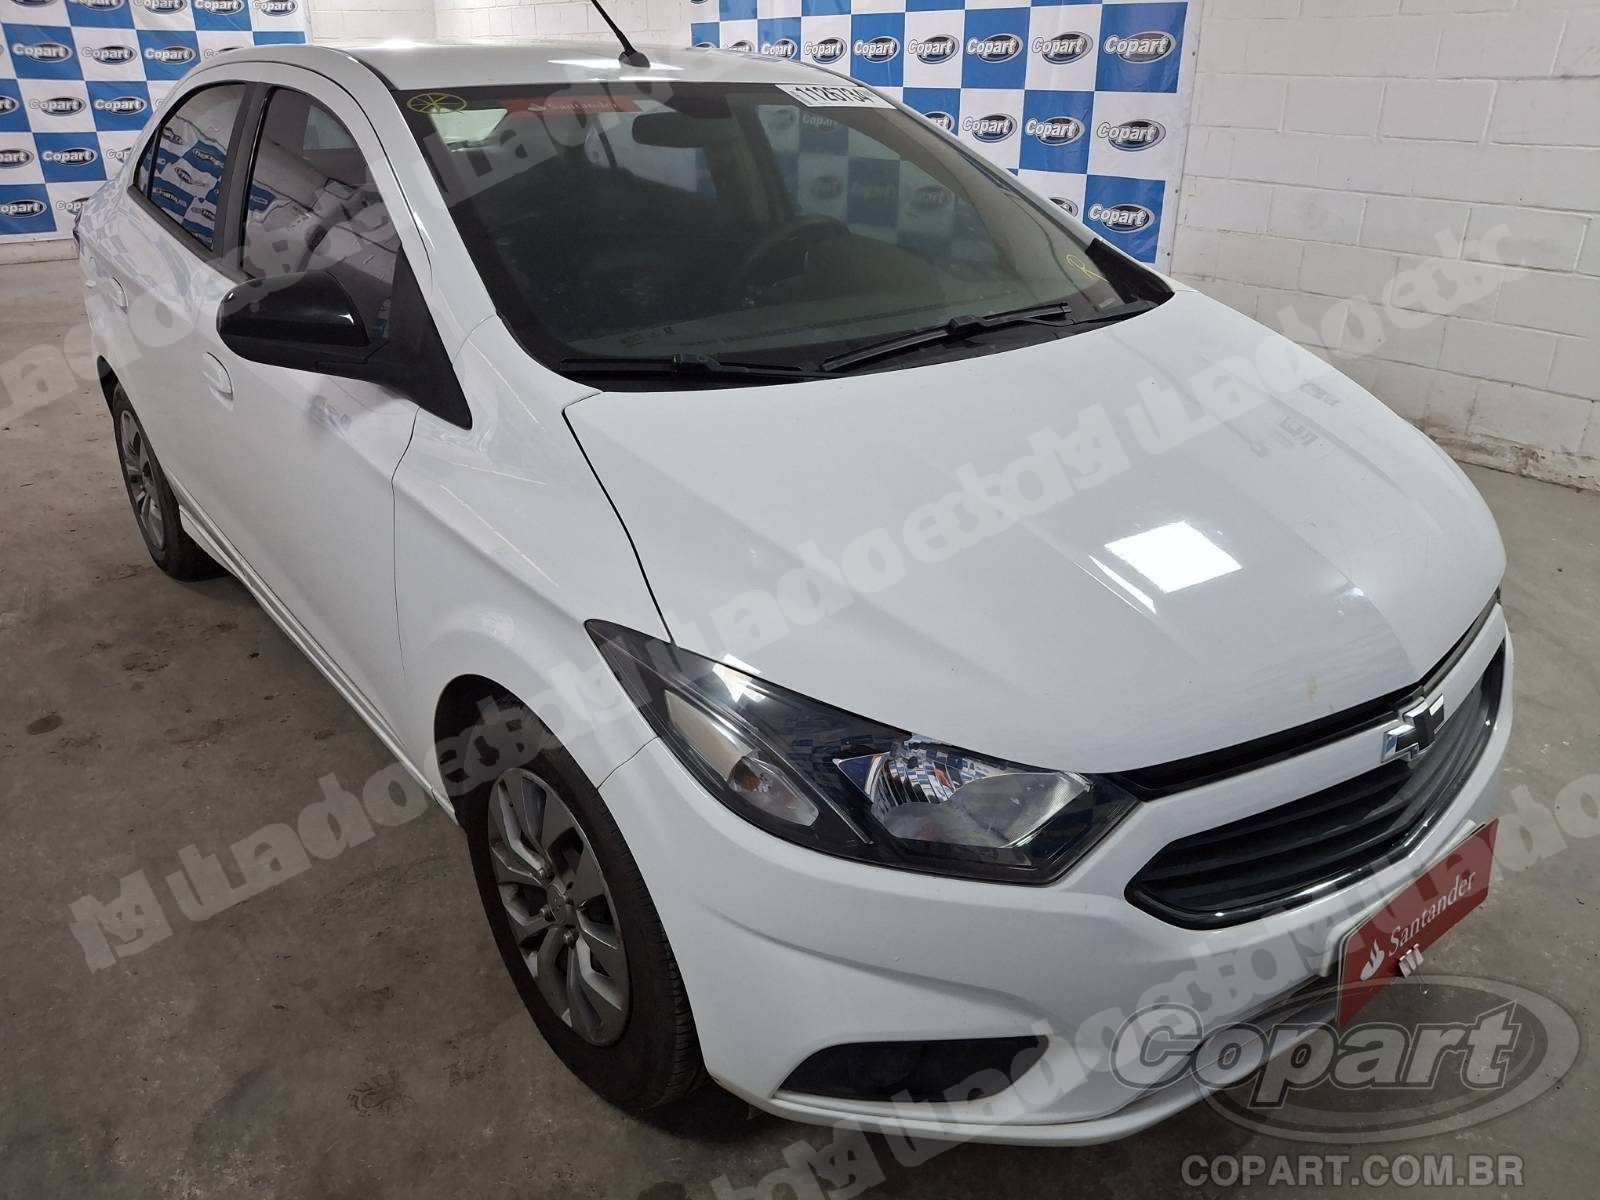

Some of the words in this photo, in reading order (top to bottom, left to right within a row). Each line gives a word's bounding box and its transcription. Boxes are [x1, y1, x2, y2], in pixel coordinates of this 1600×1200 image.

[195, 0, 240, 9] Copart
[253, 1, 292, 11] Copart
[12, 43, 66, 59] Copart
[81, 46, 130, 60] Copart
[804, 41, 843, 56] Copart
[855, 40, 895, 56] Copart
[908, 39, 953, 57] Copart
[967, 37, 1018, 58] Copart
[1032, 37, 1083, 58] Copart
[1104, 34, 1170, 56] Copart
[144, 46, 190, 61] Copart
[30, 99, 82, 112] Copart
[95, 99, 142, 112] Copart
[962, 116, 1010, 136] Copart
[1025, 118, 1077, 140] Copart
[1096, 121, 1157, 143] Copart
[42, 150, 93, 163] Copart
[0, 203, 39, 216] opart
[1088, 203, 1148, 227] Copart
[1388, 871, 1476, 957] Santander
